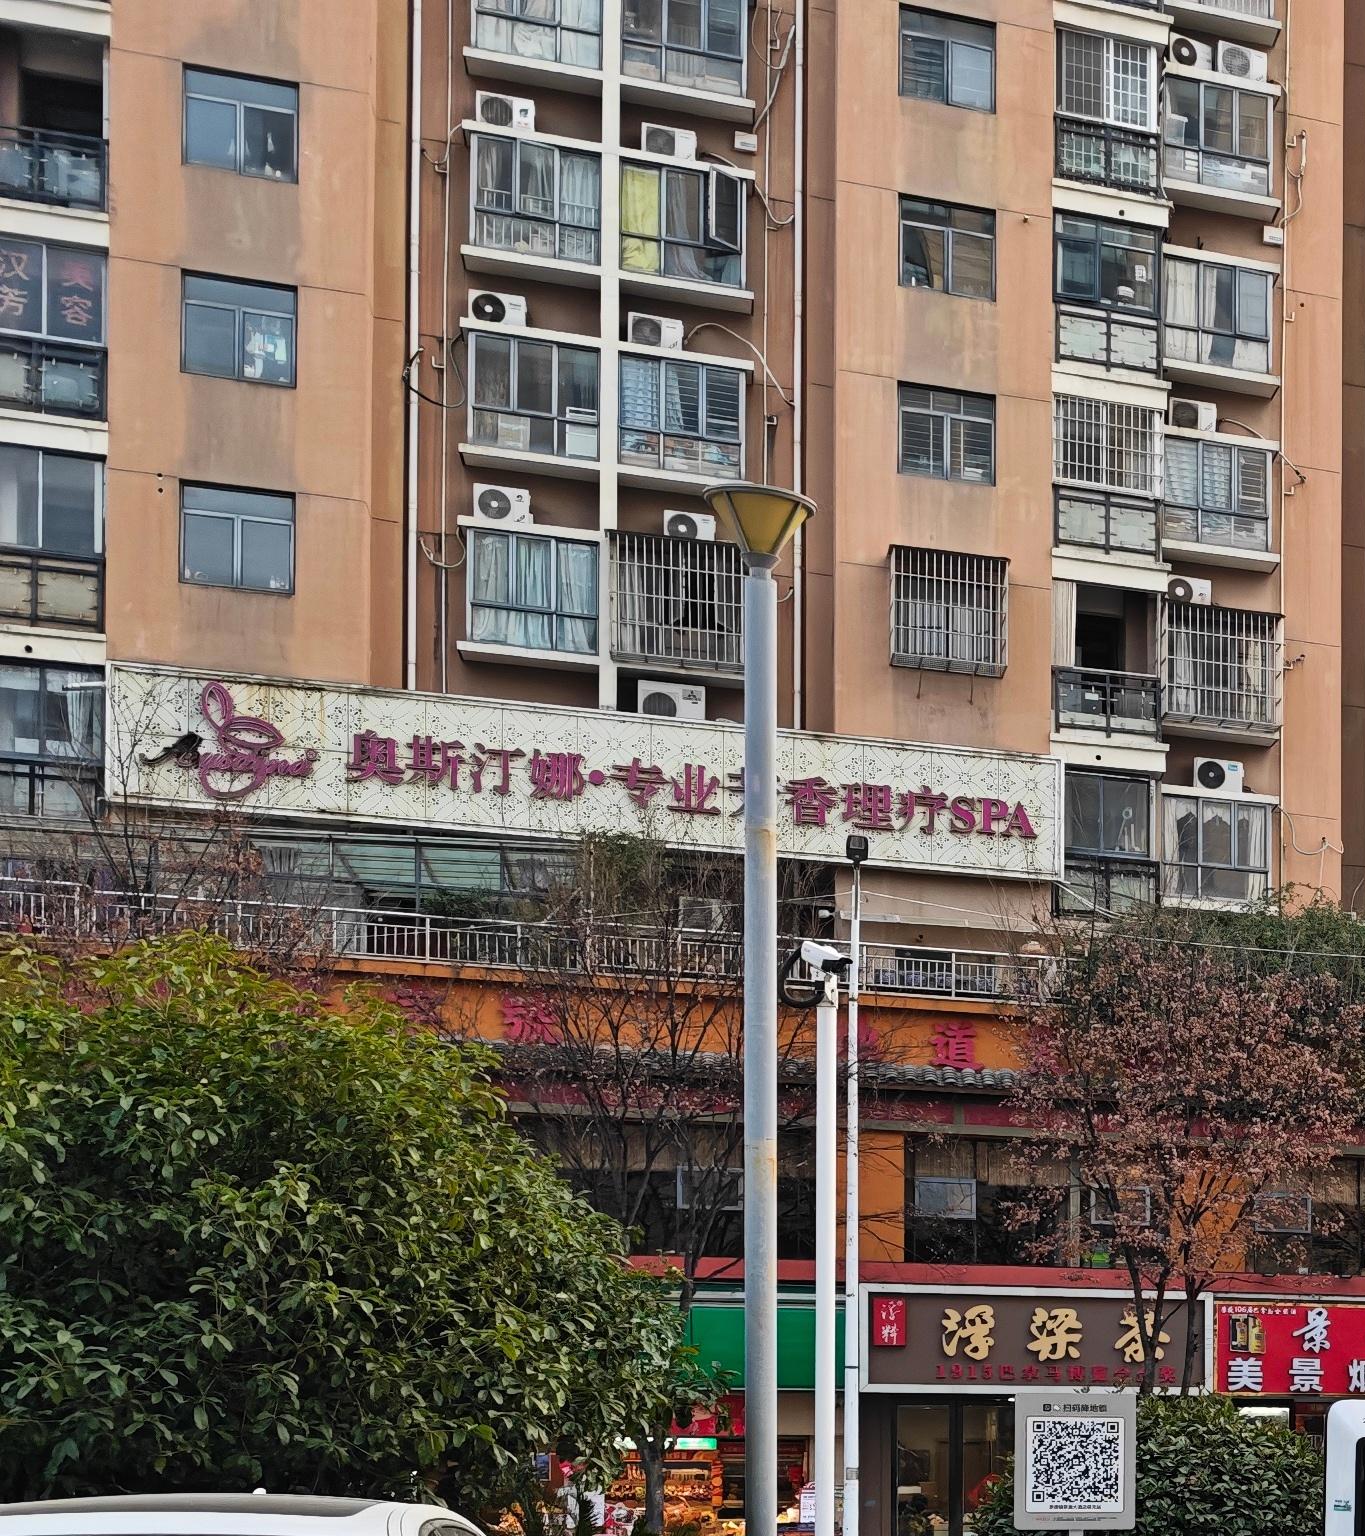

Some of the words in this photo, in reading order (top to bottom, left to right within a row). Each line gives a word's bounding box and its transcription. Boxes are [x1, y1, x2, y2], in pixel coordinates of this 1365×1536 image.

[345, 729, 1037, 839] 奥斯汀娜·专业香理疗SPA
